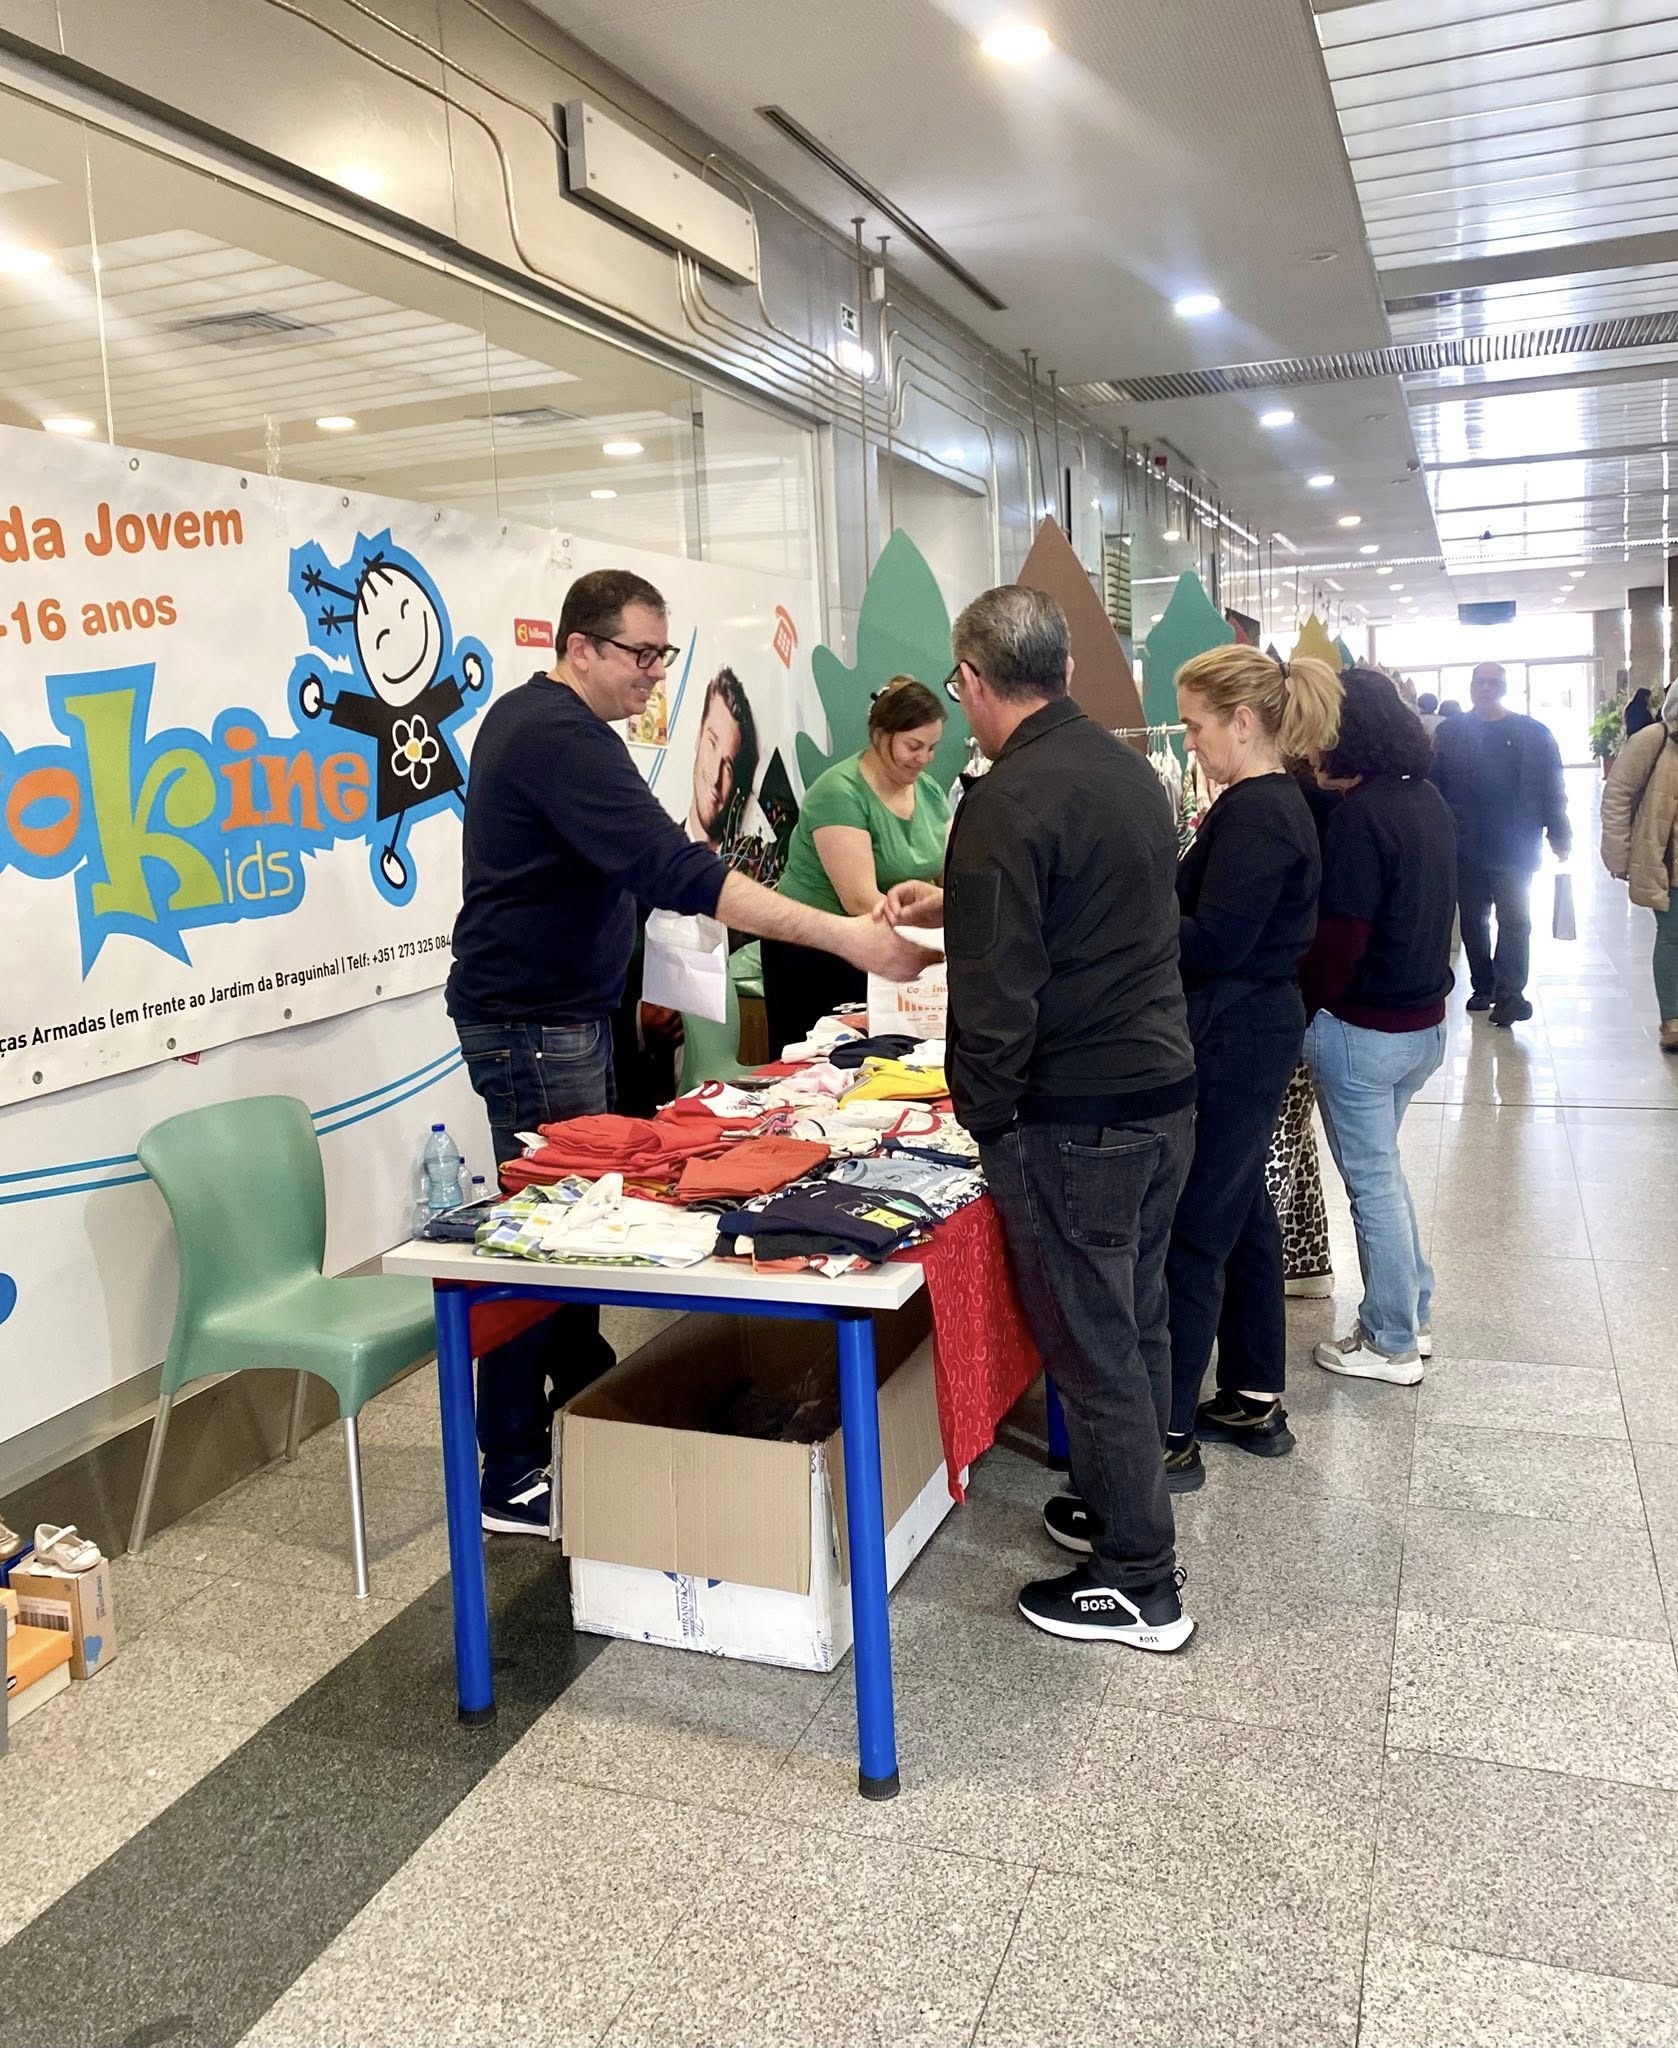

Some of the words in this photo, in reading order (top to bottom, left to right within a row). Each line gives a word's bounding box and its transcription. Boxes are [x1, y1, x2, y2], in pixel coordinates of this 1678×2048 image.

[84, 502, 243, 557] Jovem
[81, 595, 177, 636] anos
[32, 1016, 106, 1046] Armadas
[110, 1008, 139, 1028] (em
[143, 997, 186, 1019] frente
[190, 993, 205, 1008] ao
[209, 982, 255, 1003] Jardim
[258, 976, 273, 992] da
[276, 958, 340, 988] Braguinha)
[347, 952, 370, 971] Telf:
[373, 946, 395, 964] +351
[398, 942, 416, 960] 273
[417, 937, 434, 954] 325
[1080, 1598, 1116, 1612] BOSS
